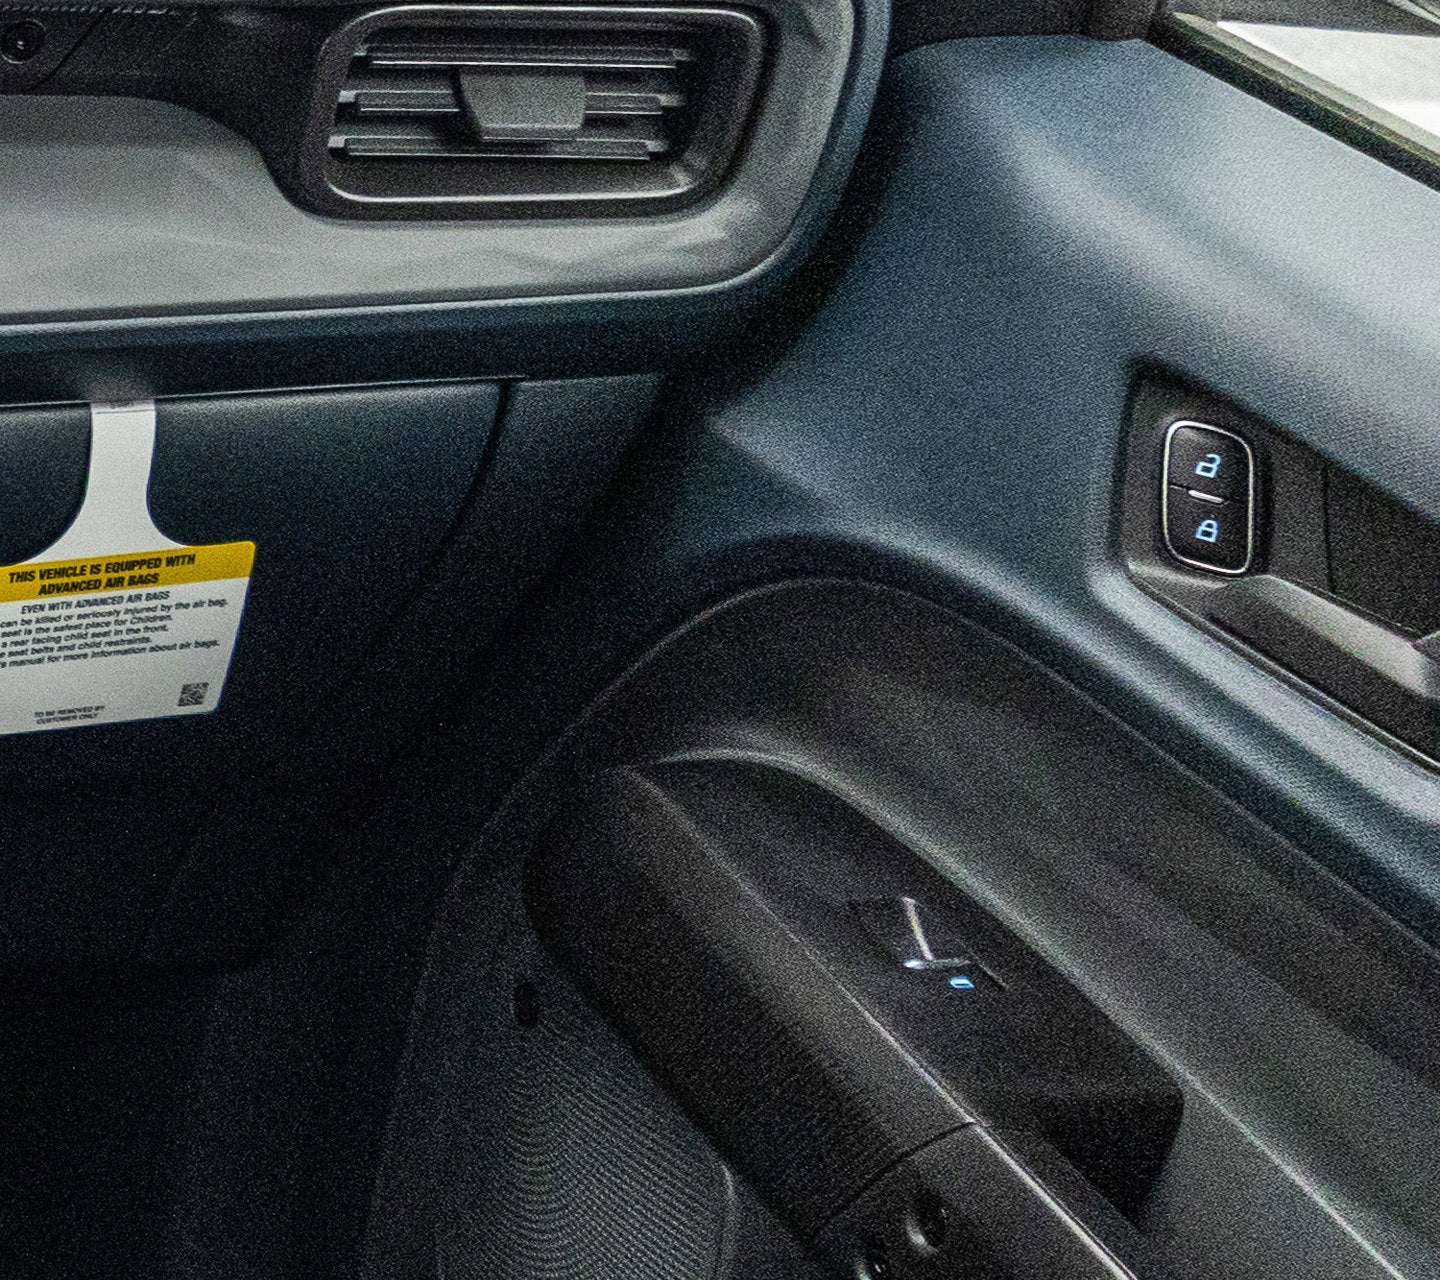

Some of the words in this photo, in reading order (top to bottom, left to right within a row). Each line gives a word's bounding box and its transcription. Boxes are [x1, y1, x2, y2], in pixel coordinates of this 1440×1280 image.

[8, 570, 36, 583] THIS
[39, 565, 87, 580] VEHICLE
[90, 563, 102, 575] IS
[105, 558, 163, 573] EQUIPPED
[165, 554, 196, 567] WITH
[38, 578, 102, 595] ADVANCED
[104, 576, 125, 589] AIR
[127, 573, 160, 586] BAGS
[21, 604, 46, 614] EVEN
[48, 601, 73, 611] WITH
[75, 595, 125, 608] ADVANCED
[126, 593, 143, 603] AIR
[145, 591, 171, 601] BAGS
[0, 620, 18, 628] can
[20, 618, 33, 626] be
[35, 614, 61, 624] killed
[77, 609, 122, 620] seriously
[123, 605, 159, 615] injured
[160, 604, 173, 613] by
[175, 601, 191, 609] the
[192, 600, 206, 608] air
[1, 629, 23, 638] seat
[53, 623, 83, 632] safest
[85, 620, 112, 630] place
[114, 618, 128, 626] for
[10, 639, 29, 647] rear
[32, 635, 62, 645] facing
[64, 632, 89, 641] child
[91, 629, 112, 638] seat
[125, 626, 142, 635] the
[7, 649, 29, 658] seat
[30, 646, 56, 655] belts
[57, 643, 76, 652] and
[78, 640, 102, 650] child
[9, 656, 46, 667] manual
[47, 654, 62, 663] for
[63, 652, 89, 661] more
[148, 643, 178, 653] about
[179, 641, 193, 650] air
